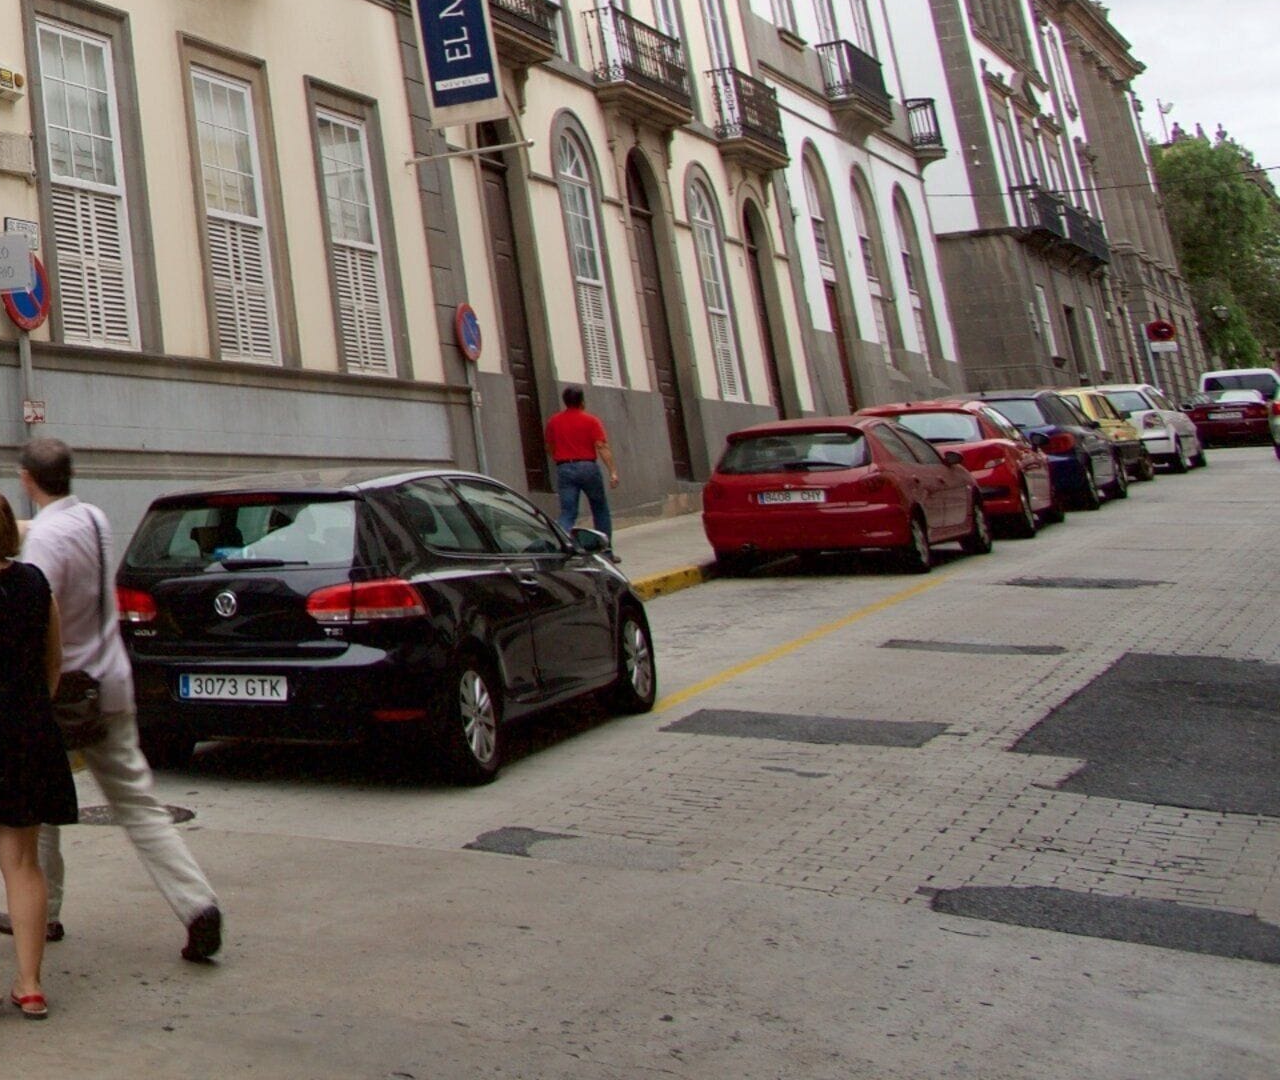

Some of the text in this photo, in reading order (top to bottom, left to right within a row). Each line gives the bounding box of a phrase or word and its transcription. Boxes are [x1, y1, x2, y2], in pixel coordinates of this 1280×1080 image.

[445, 27, 473, 63] EL
[193, 677, 281, 697] 3073 GTK
